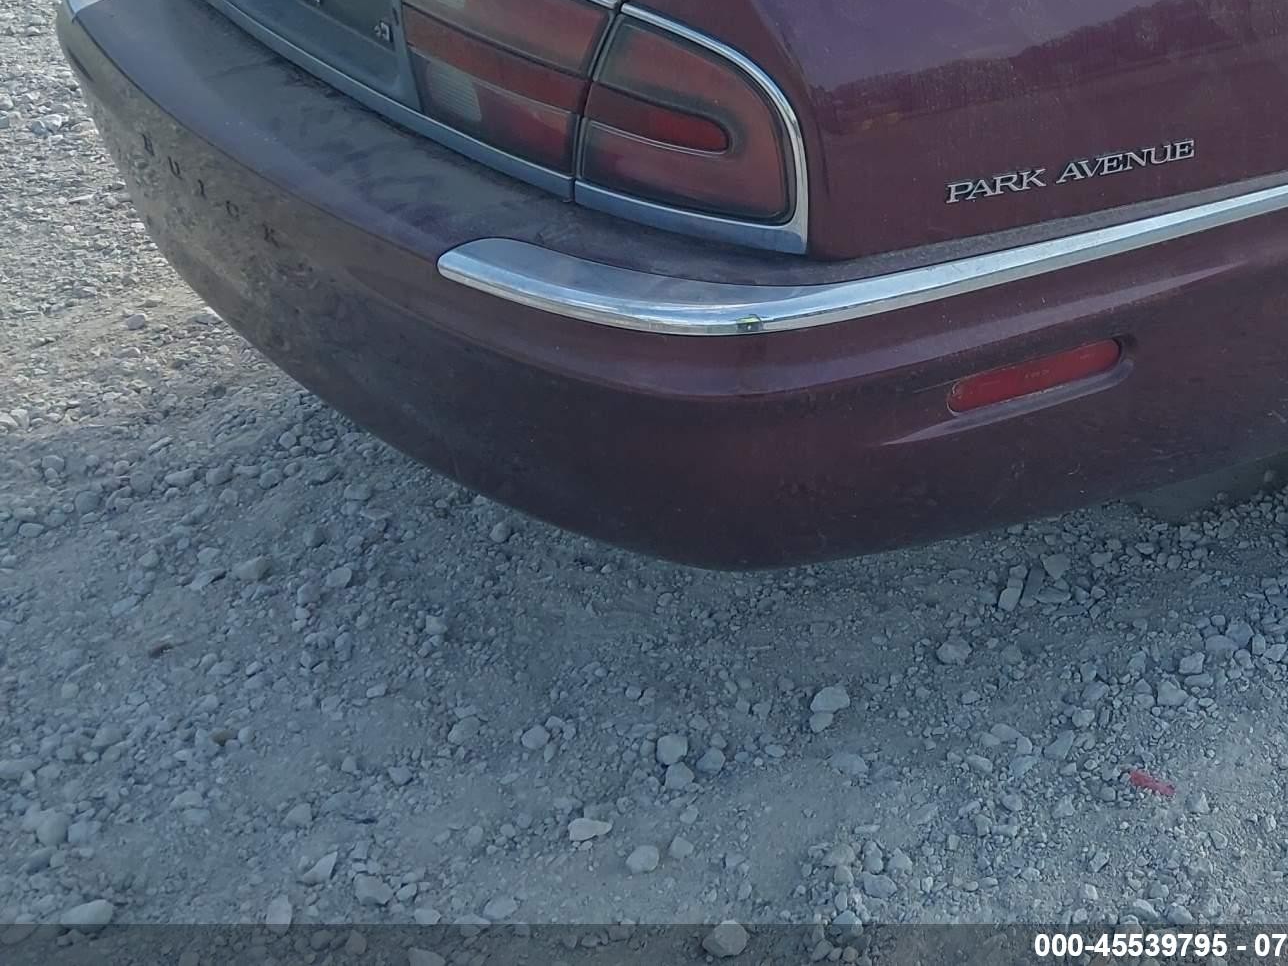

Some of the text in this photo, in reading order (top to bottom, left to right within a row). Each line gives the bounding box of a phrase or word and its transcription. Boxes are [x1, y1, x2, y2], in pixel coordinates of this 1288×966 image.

[142, 133, 280, 249] BUICK
[946, 140, 1195, 204] PARK AVENUE
